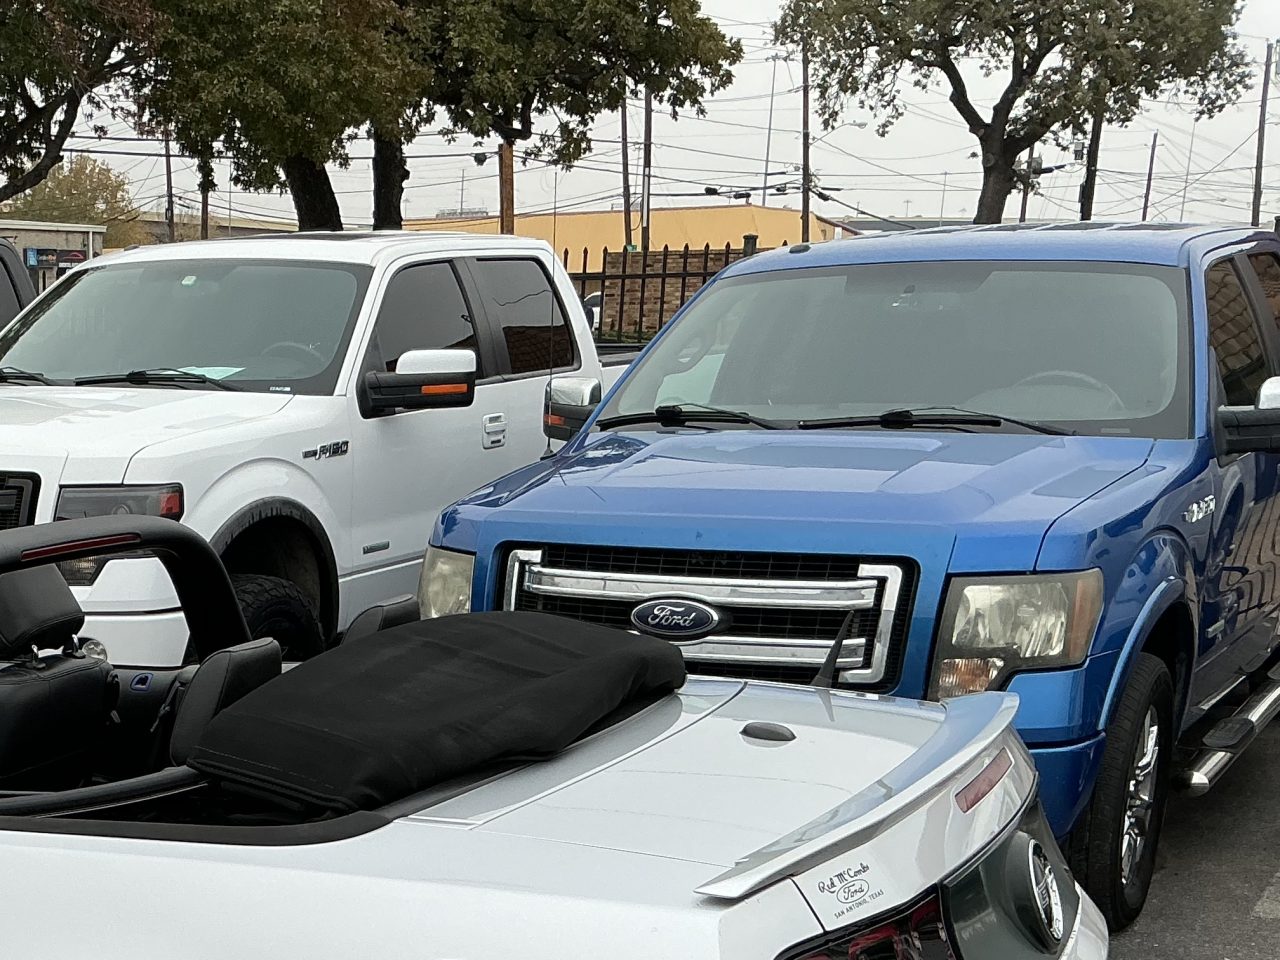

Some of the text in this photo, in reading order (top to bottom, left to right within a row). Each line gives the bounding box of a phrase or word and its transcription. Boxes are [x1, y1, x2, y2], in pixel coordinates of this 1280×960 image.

[648, 605, 696, 627] Ford
[818, 877, 837, 894] Red
[843, 883, 864, 900] Ford
[834, 911, 846, 919] SAN
[868, 889, 884, 901] TEXAS
